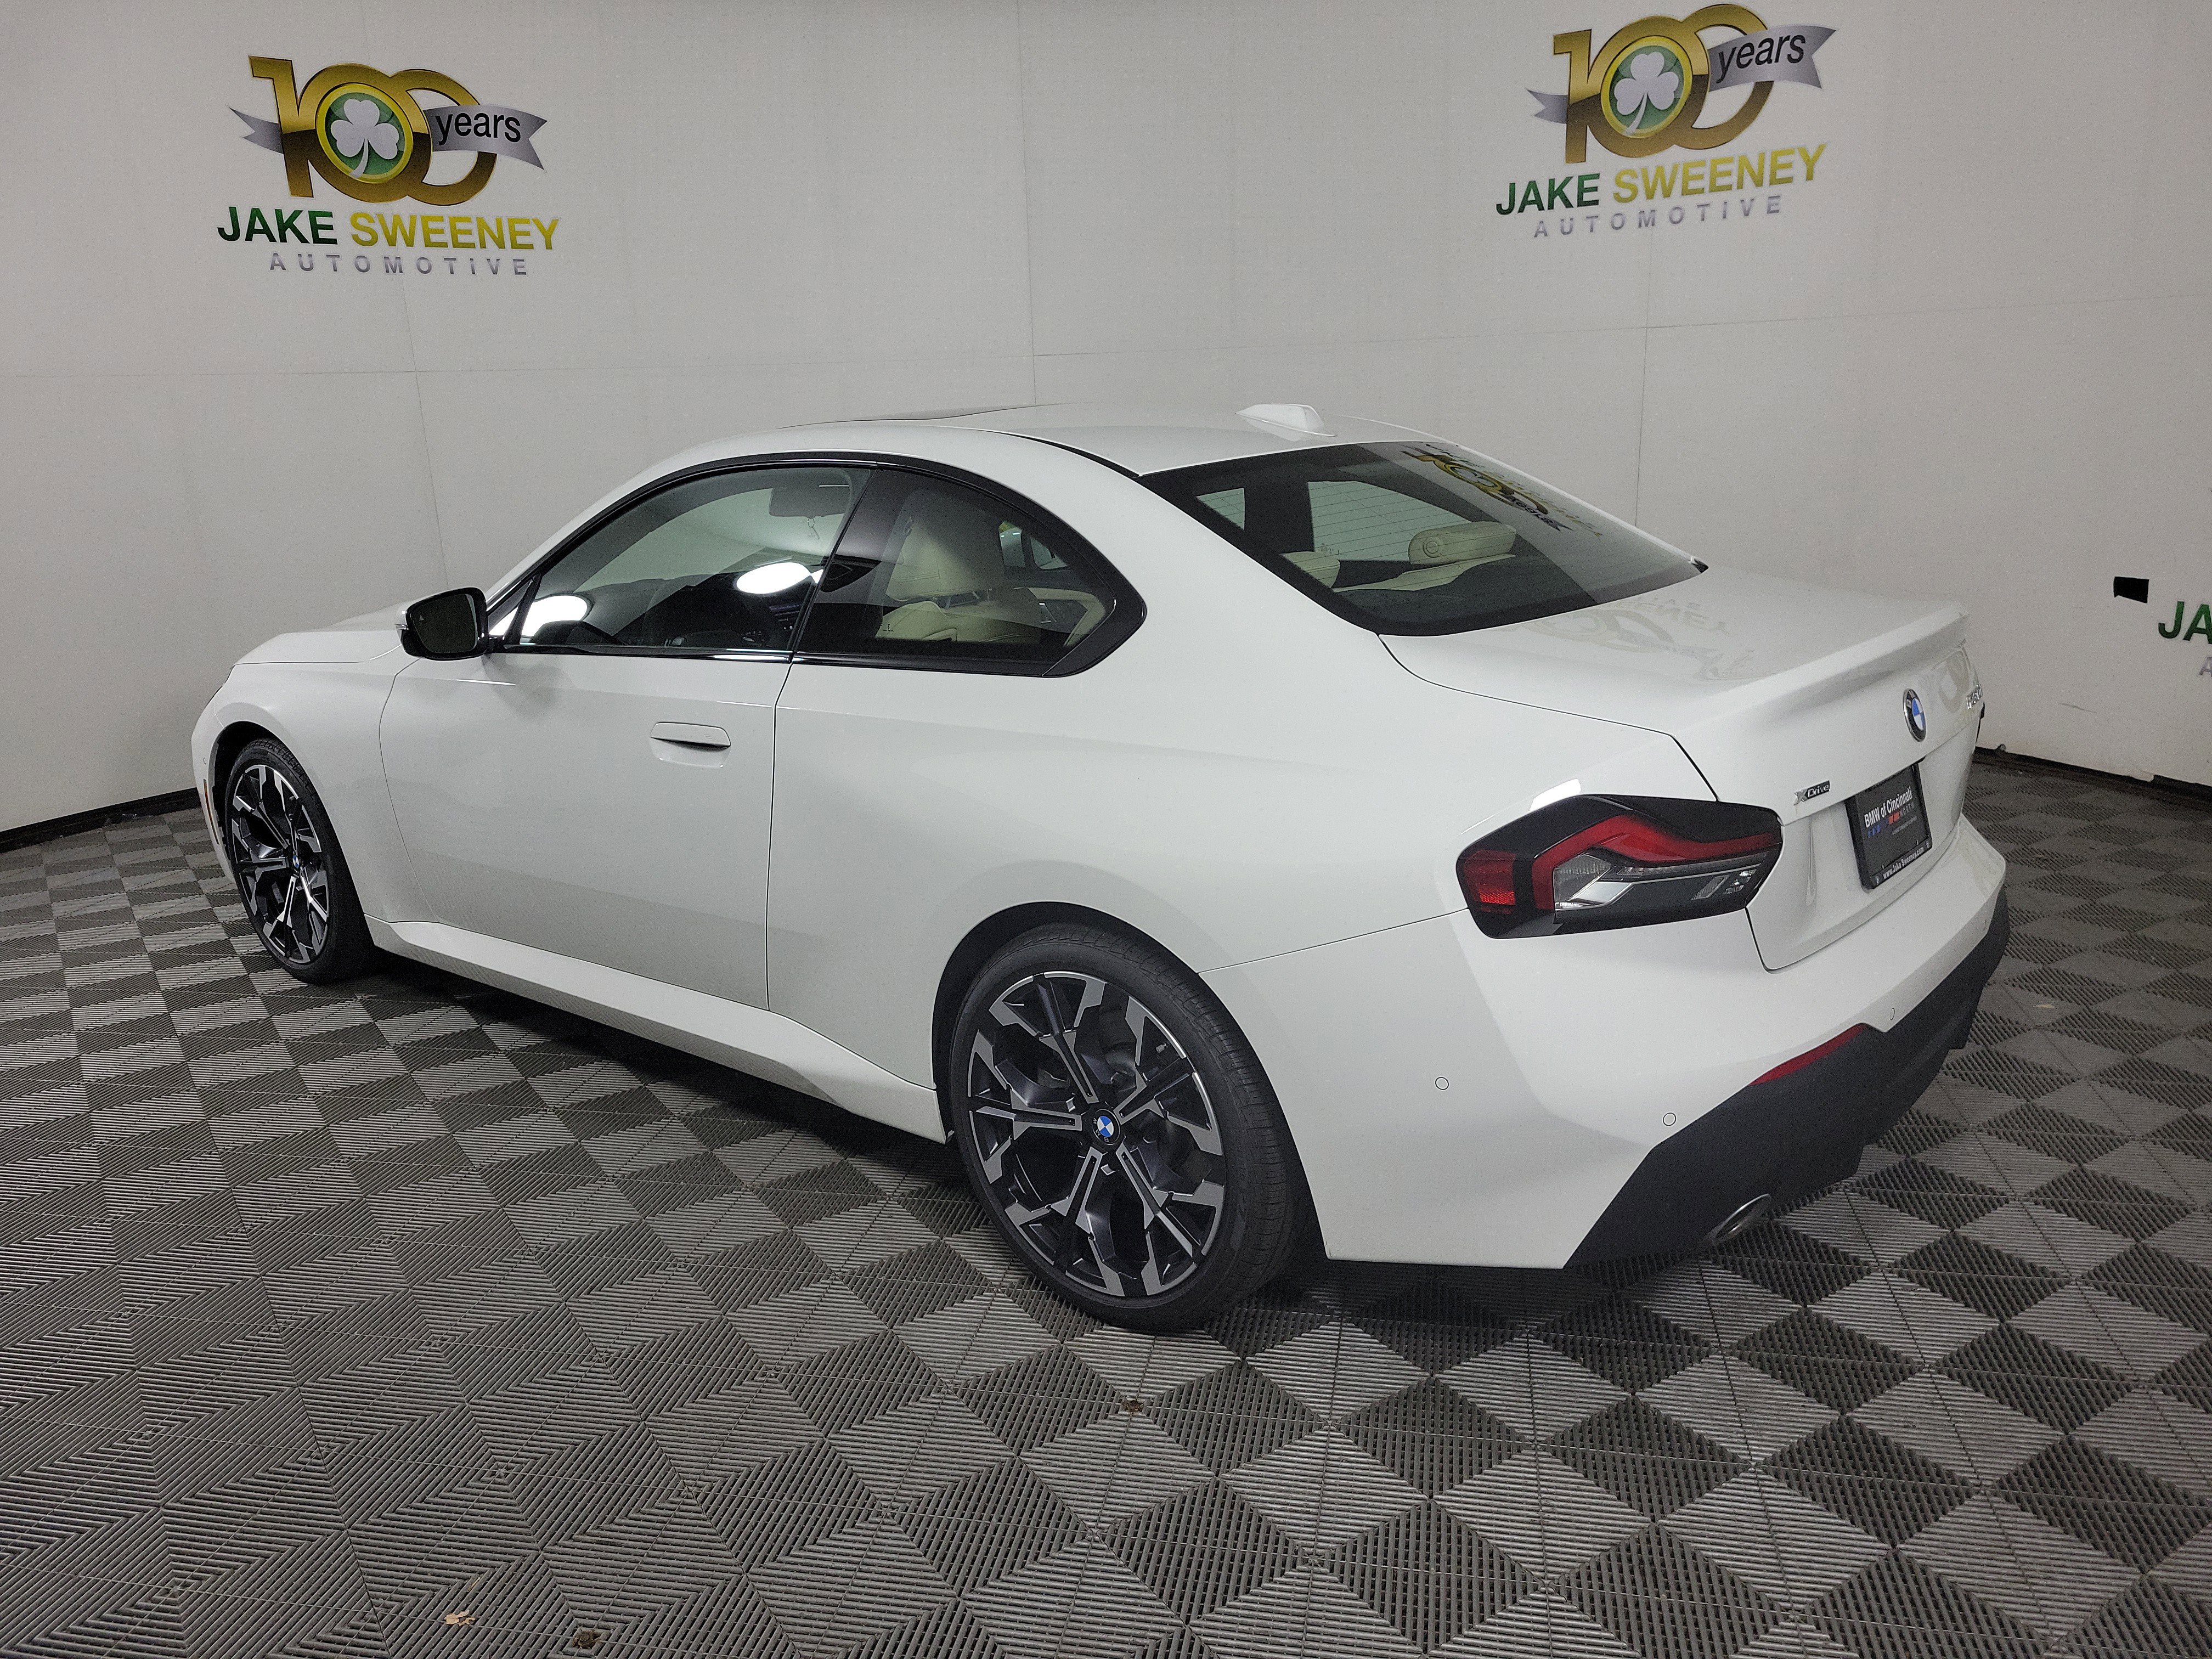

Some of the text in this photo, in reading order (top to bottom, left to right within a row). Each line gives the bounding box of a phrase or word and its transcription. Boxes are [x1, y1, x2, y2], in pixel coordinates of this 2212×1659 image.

[1717, 34, 1805, 83] years
[1553, 4, 1774, 164] 100
[248, 55, 497, 206] 100
[435, 112, 521, 145] years
[1496, 144, 1827, 215] JAKE SWEENEY
[217, 206, 560, 250] JAKE SWEENEY
[1533, 195, 1780, 238] AUTOMOTIVE
[270, 253, 527, 275] AUTOMOTIVE
[1864, 806, 1881, 828] BMW
[1880, 803, 1888, 818] of
[1886, 786, 1913, 814] Cincinnati
